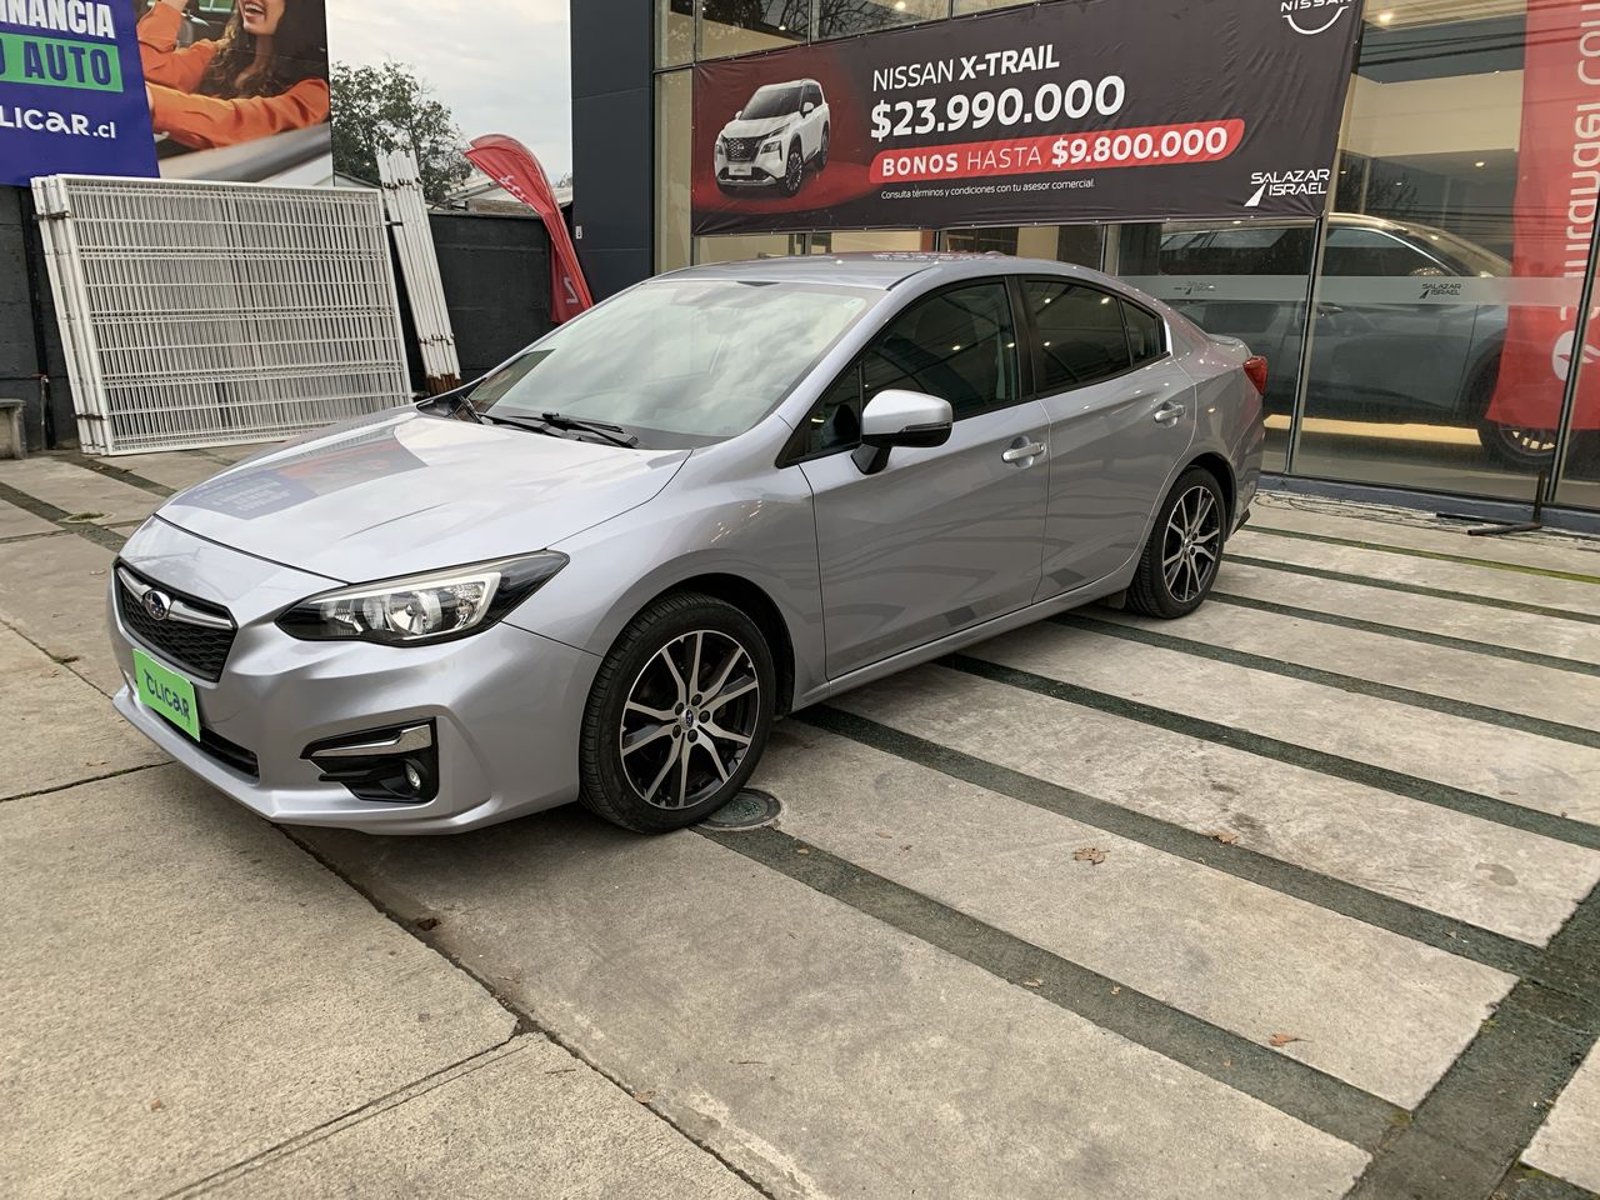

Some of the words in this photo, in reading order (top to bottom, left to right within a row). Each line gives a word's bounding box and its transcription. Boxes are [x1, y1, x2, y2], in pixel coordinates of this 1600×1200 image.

[23, 40, 112, 86] AUTO
[872, 58, 954, 92] NISSAN
[958, 43, 1060, 81] X-TRAIL
[870, 75, 1126, 142] $23.990.000
[882, 152, 959, 176] BONOS
[966, 145, 1042, 171] HASTA
[1051, 126, 1228, 167] $9.800.000
[881, 189, 911, 200] Consulta
[912, 188, 944, 199] términos
[950, 184, 995, 196] condiciones
[996, 184, 1012, 193] con
[1012, 183, 1022, 192] tu
[1022, 181, 1051, 192] asesor
[1250, 168, 1330, 185] SALAZAR
[1268, 182, 1327, 196] ISRAEL
